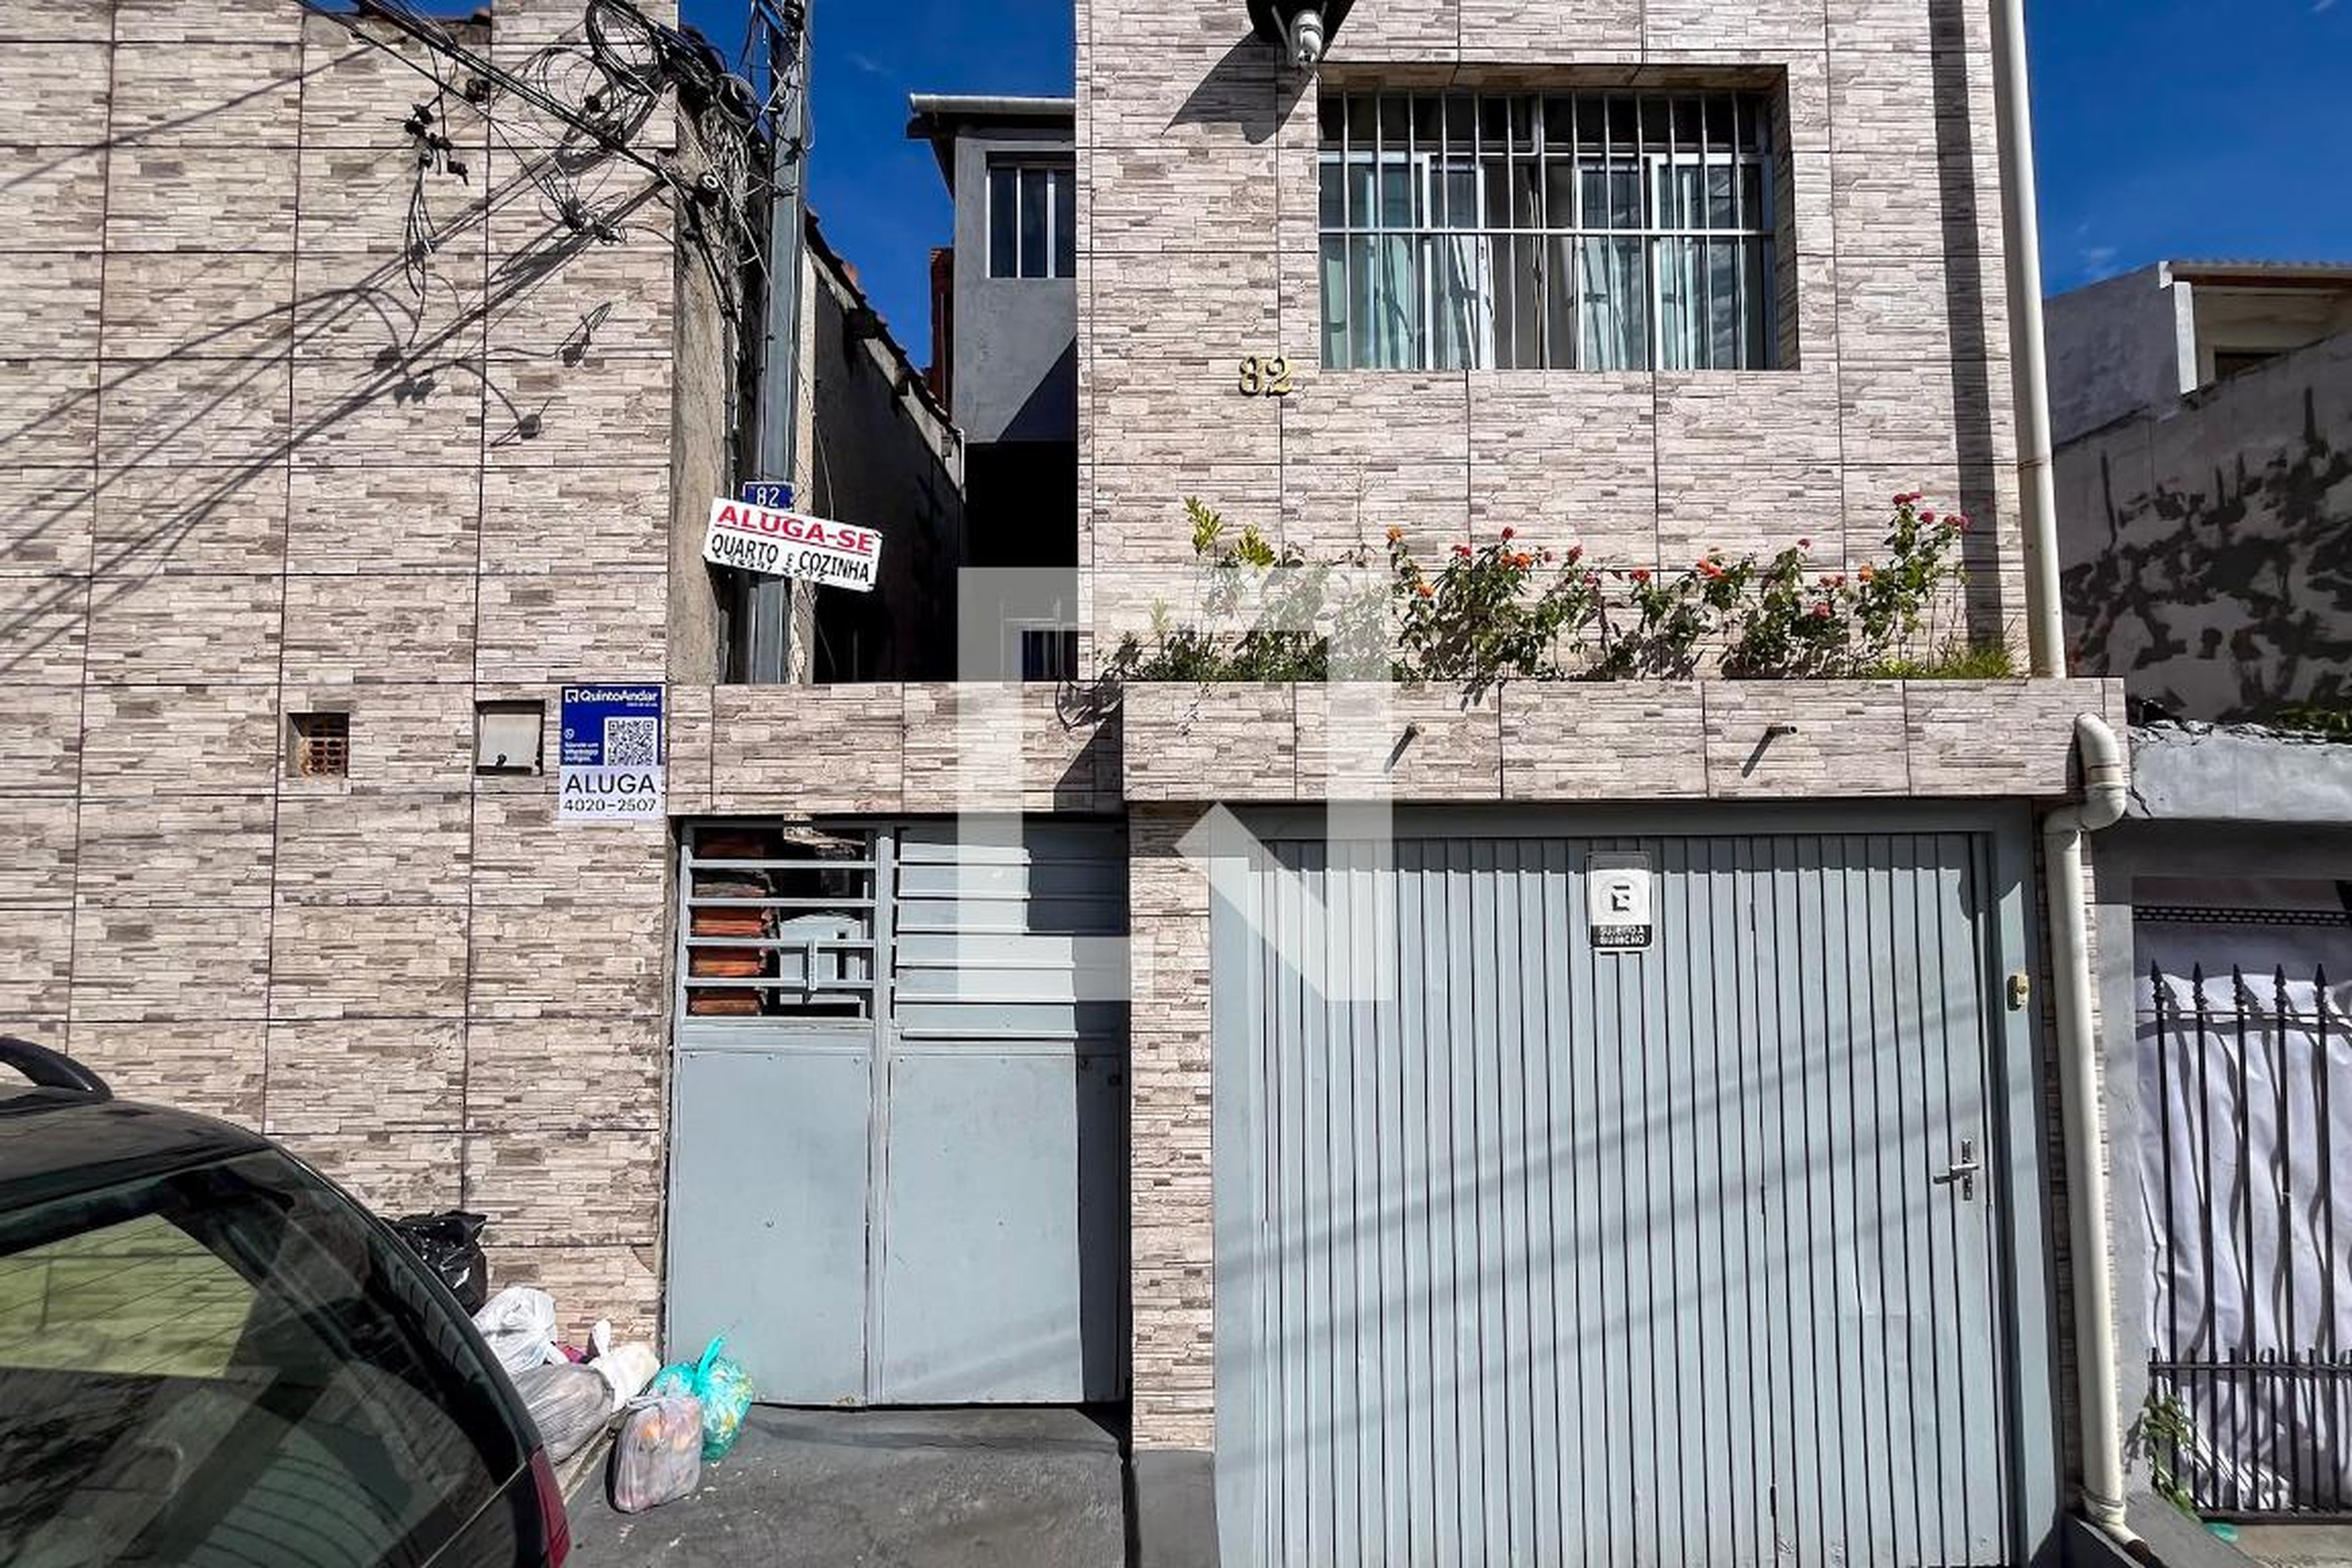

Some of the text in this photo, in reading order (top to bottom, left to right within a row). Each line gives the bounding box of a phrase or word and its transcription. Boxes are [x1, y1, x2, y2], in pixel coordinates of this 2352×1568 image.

[1239, 356, 1292, 398] 82
[756, 486, 780, 507] 82
[717, 505, 875, 552] ALUGA-SE
[711, 533, 779, 564] QUARTO
[799, 551, 869, 582] COZINHA
[579, 689, 658, 702] QuintoAndar
[565, 773, 656, 794] ALUGA
[563, 798, 657, 812] 4020-2507
